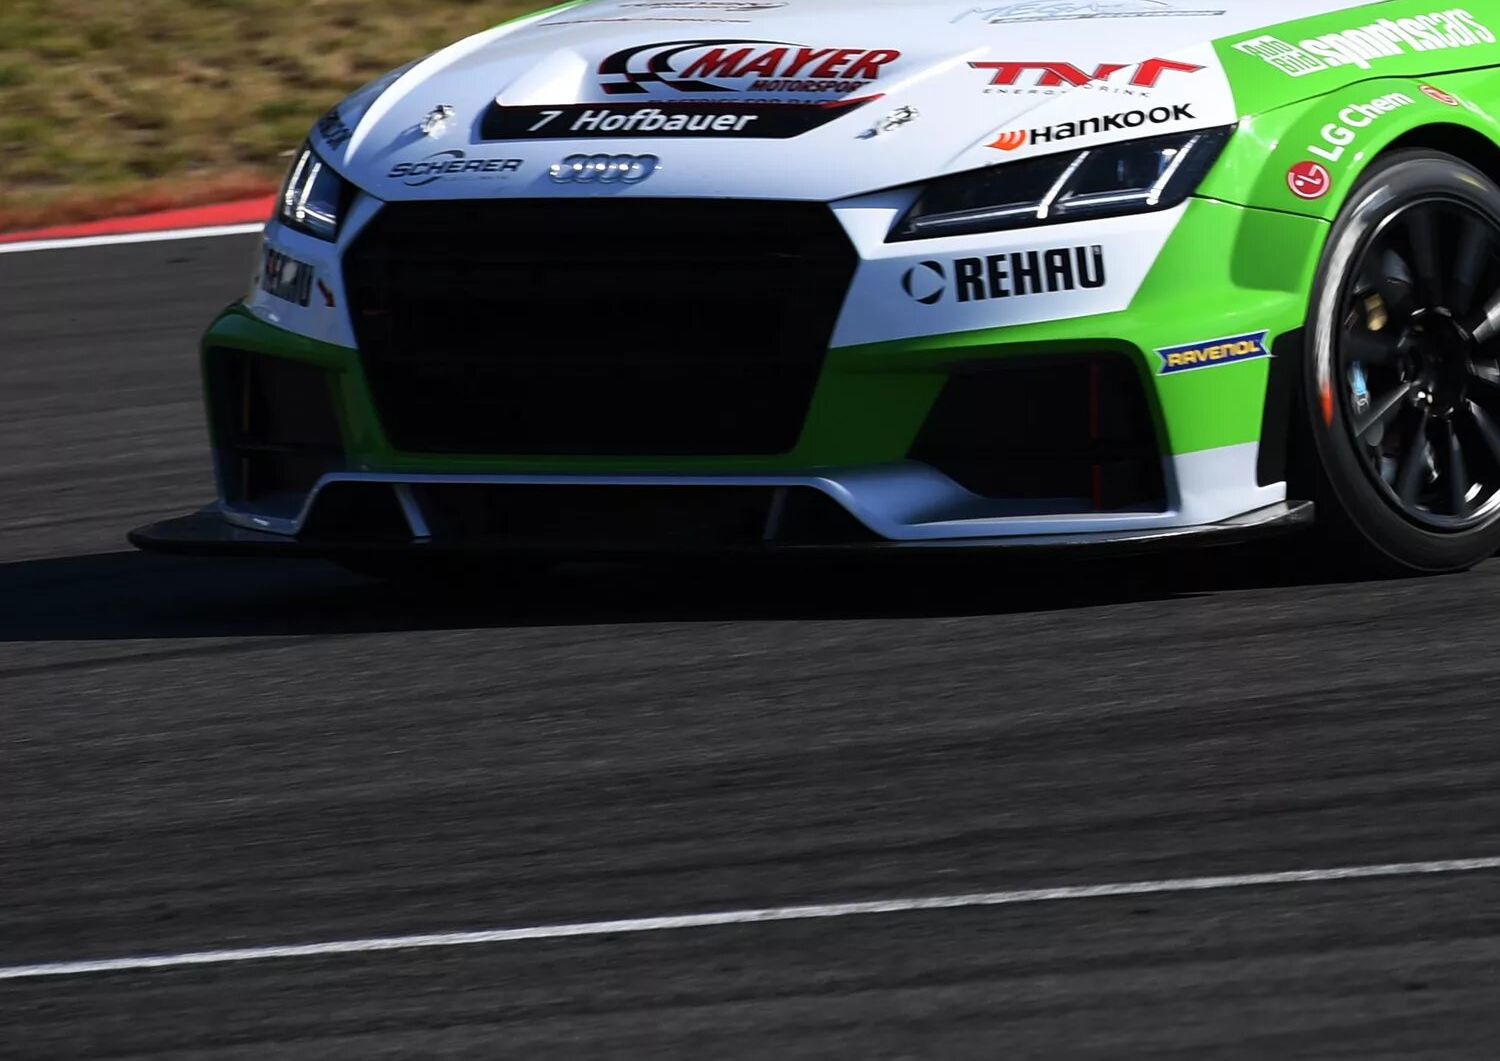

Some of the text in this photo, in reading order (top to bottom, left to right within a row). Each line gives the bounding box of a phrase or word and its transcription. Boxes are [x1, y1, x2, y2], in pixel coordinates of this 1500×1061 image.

[1299, 8, 1496, 70] sportscars
[678, 47, 902, 79] MAYER
[524, 108, 759, 131] 7 Hofbauer
[1307, 92, 1416, 162] LG Chem
[388, 158, 524, 178] SCHERER
[952, 244, 1107, 303] REHAU
[1166, 339, 1261, 368] RAVENOL
